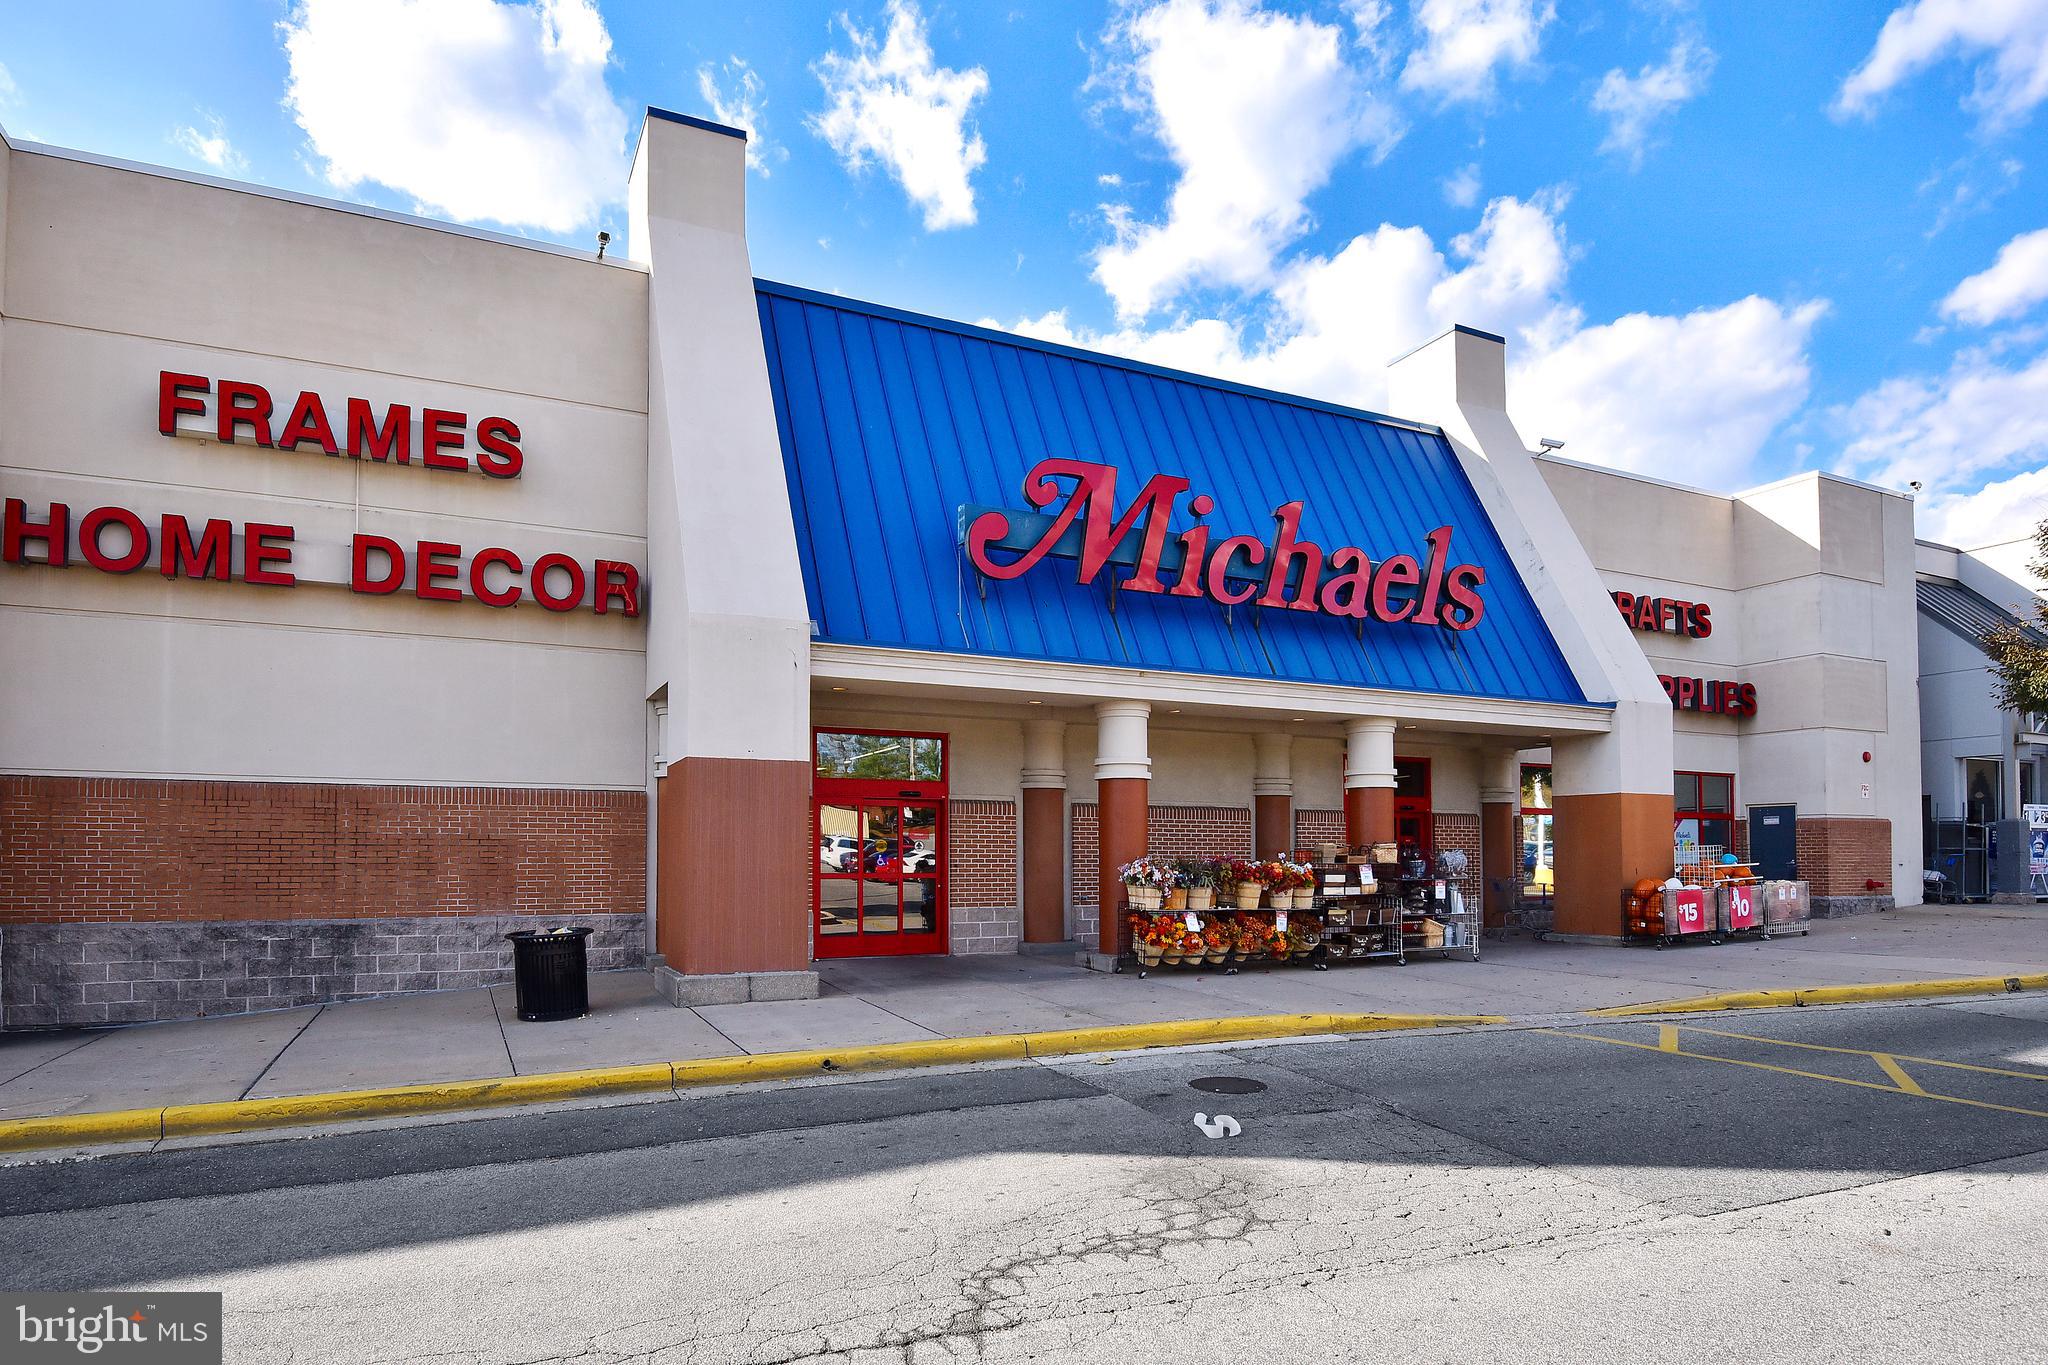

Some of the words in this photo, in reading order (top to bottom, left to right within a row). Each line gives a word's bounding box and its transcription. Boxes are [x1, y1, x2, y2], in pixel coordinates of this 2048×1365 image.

[159, 370, 523, 478] FRAMES
[3, 498, 295, 587] HOME
[351, 534, 640, 618] DECOR
[966, 458, 1487, 631] Michaels
[1610, 590, 1713, 638] RAFTS
[1678, 903, 1698, 921] $15
